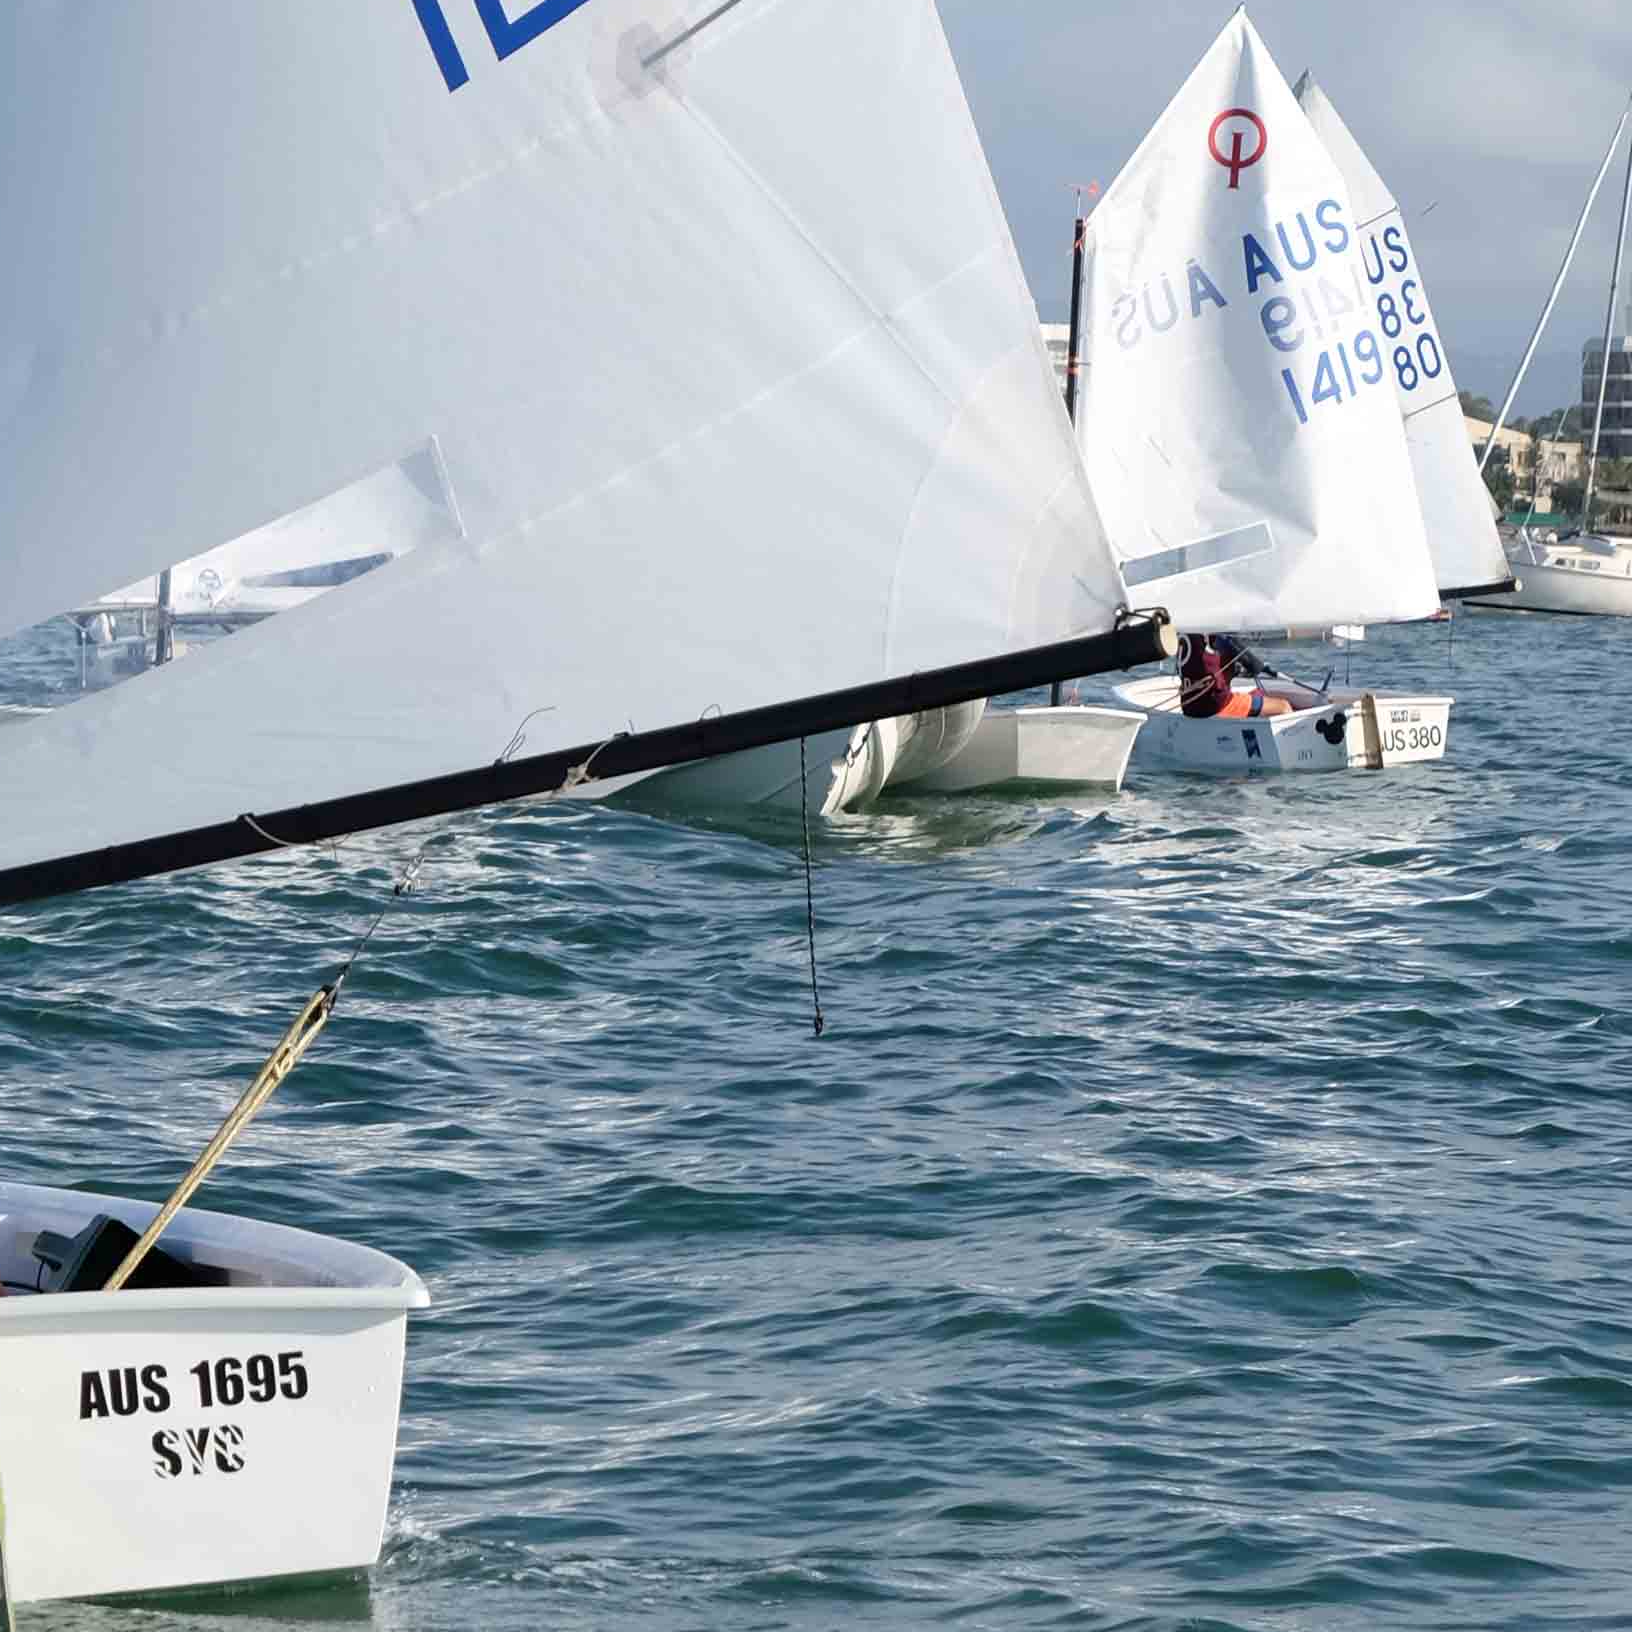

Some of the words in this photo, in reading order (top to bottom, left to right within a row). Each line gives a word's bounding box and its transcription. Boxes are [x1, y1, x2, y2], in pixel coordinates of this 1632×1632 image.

[1242, 199, 1349, 294] AUS
[1360, 226, 1409, 285] US
[1281, 330, 1384, 425] 1419
[1393, 332, 1442, 391] 80
[1382, 728, 1406, 752] US
[1409, 724, 1442, 749] 380
[79, 1364, 171, 1420] AUS
[190, 1351, 309, 1409] 1695
